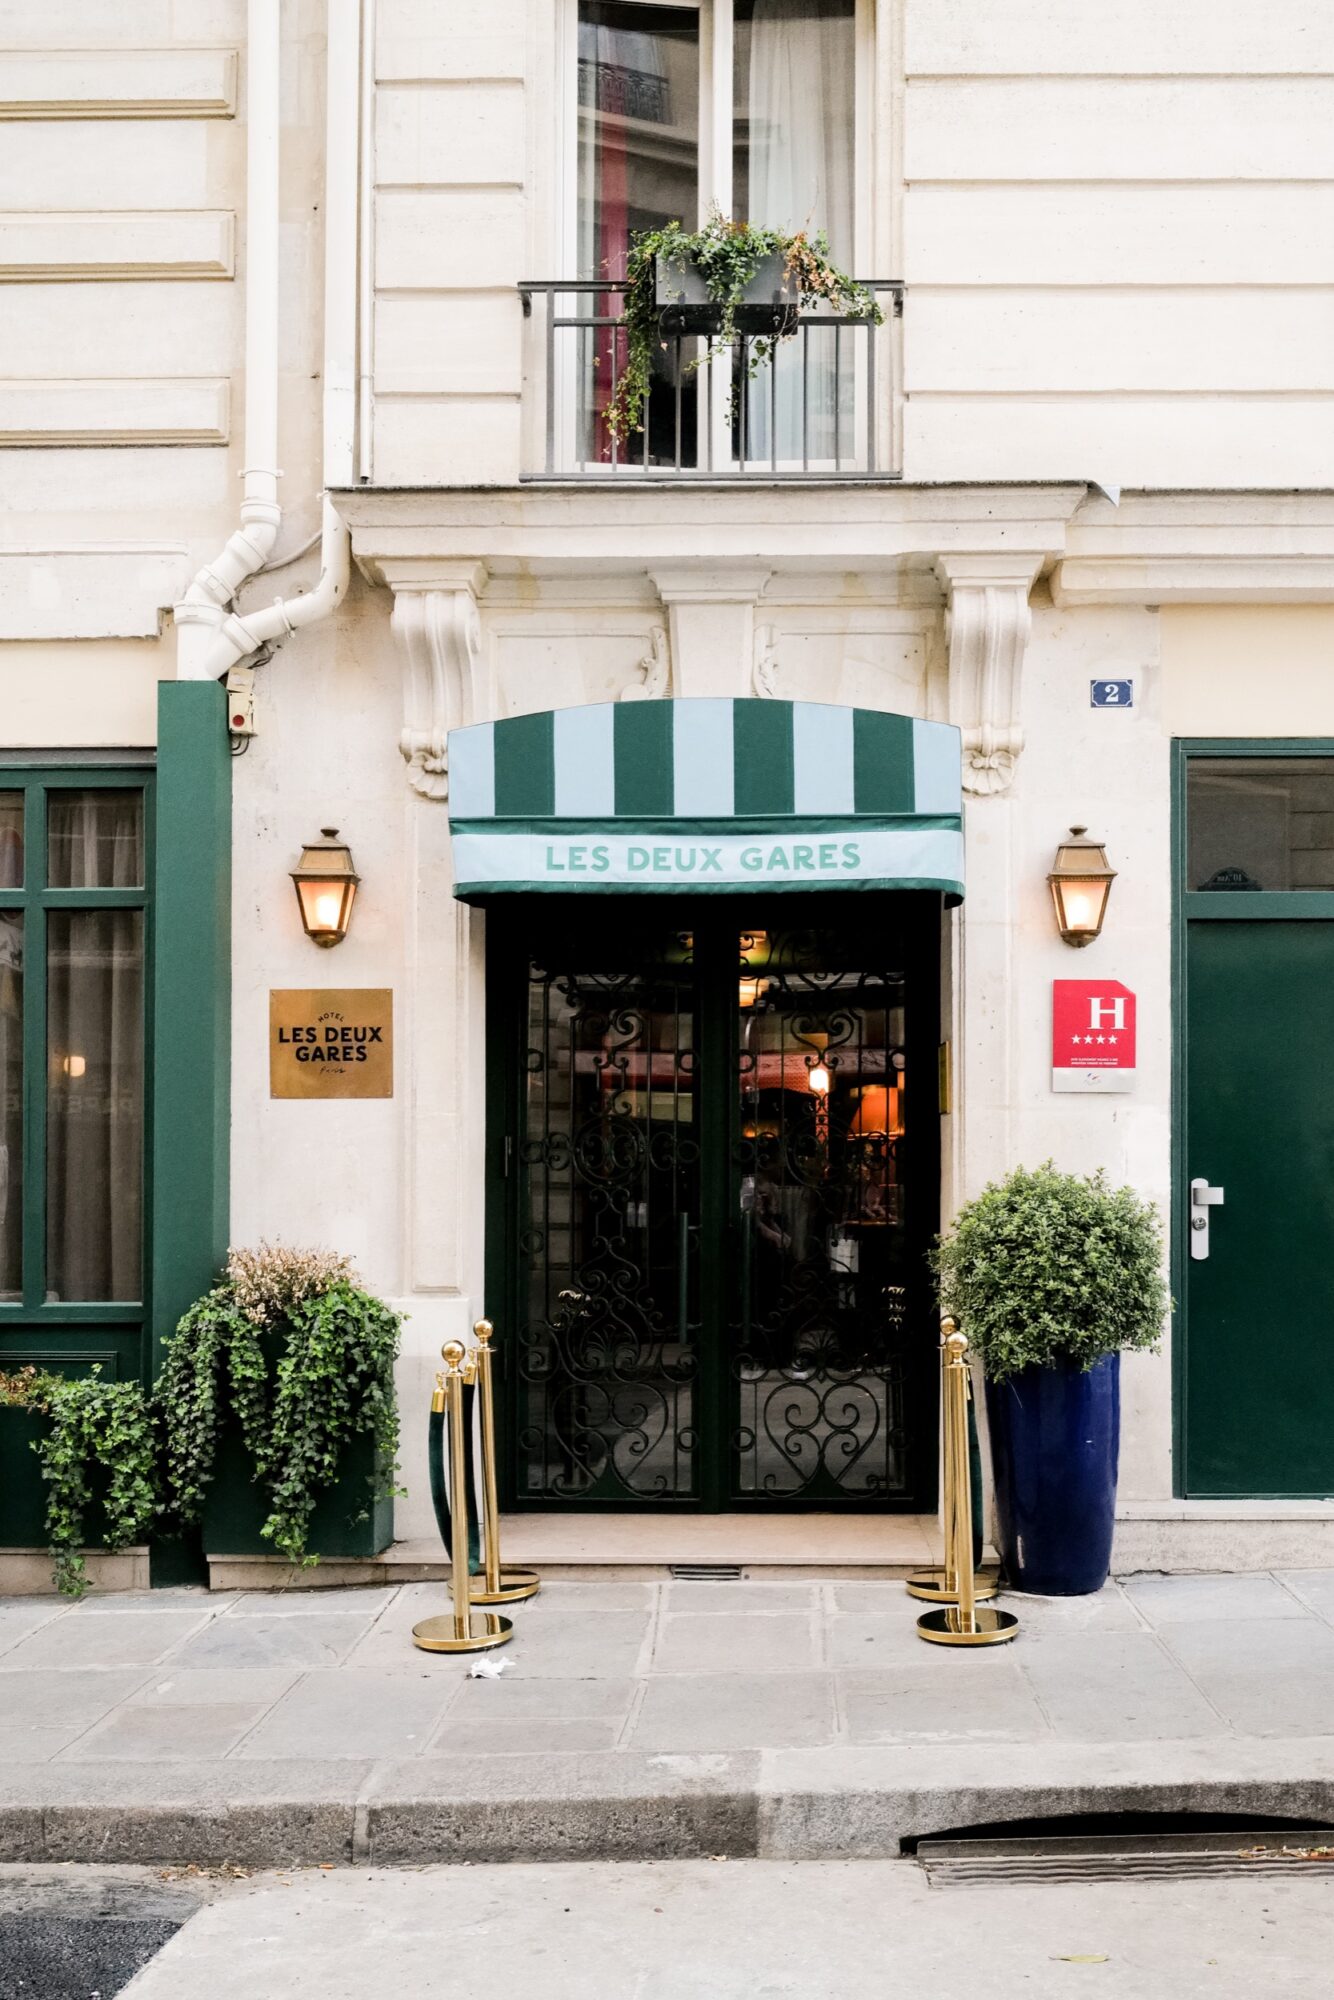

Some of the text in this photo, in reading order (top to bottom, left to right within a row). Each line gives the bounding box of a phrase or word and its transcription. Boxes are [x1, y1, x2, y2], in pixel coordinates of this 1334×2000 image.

[1105, 684, 1119, 702] 2
[546, 843, 861, 872] LES DEUX GARES
[1086, 997, 1129, 1030] H
[278, 1026, 383, 1043] LES DEUX
[295, 1045, 367, 1062] GARES
